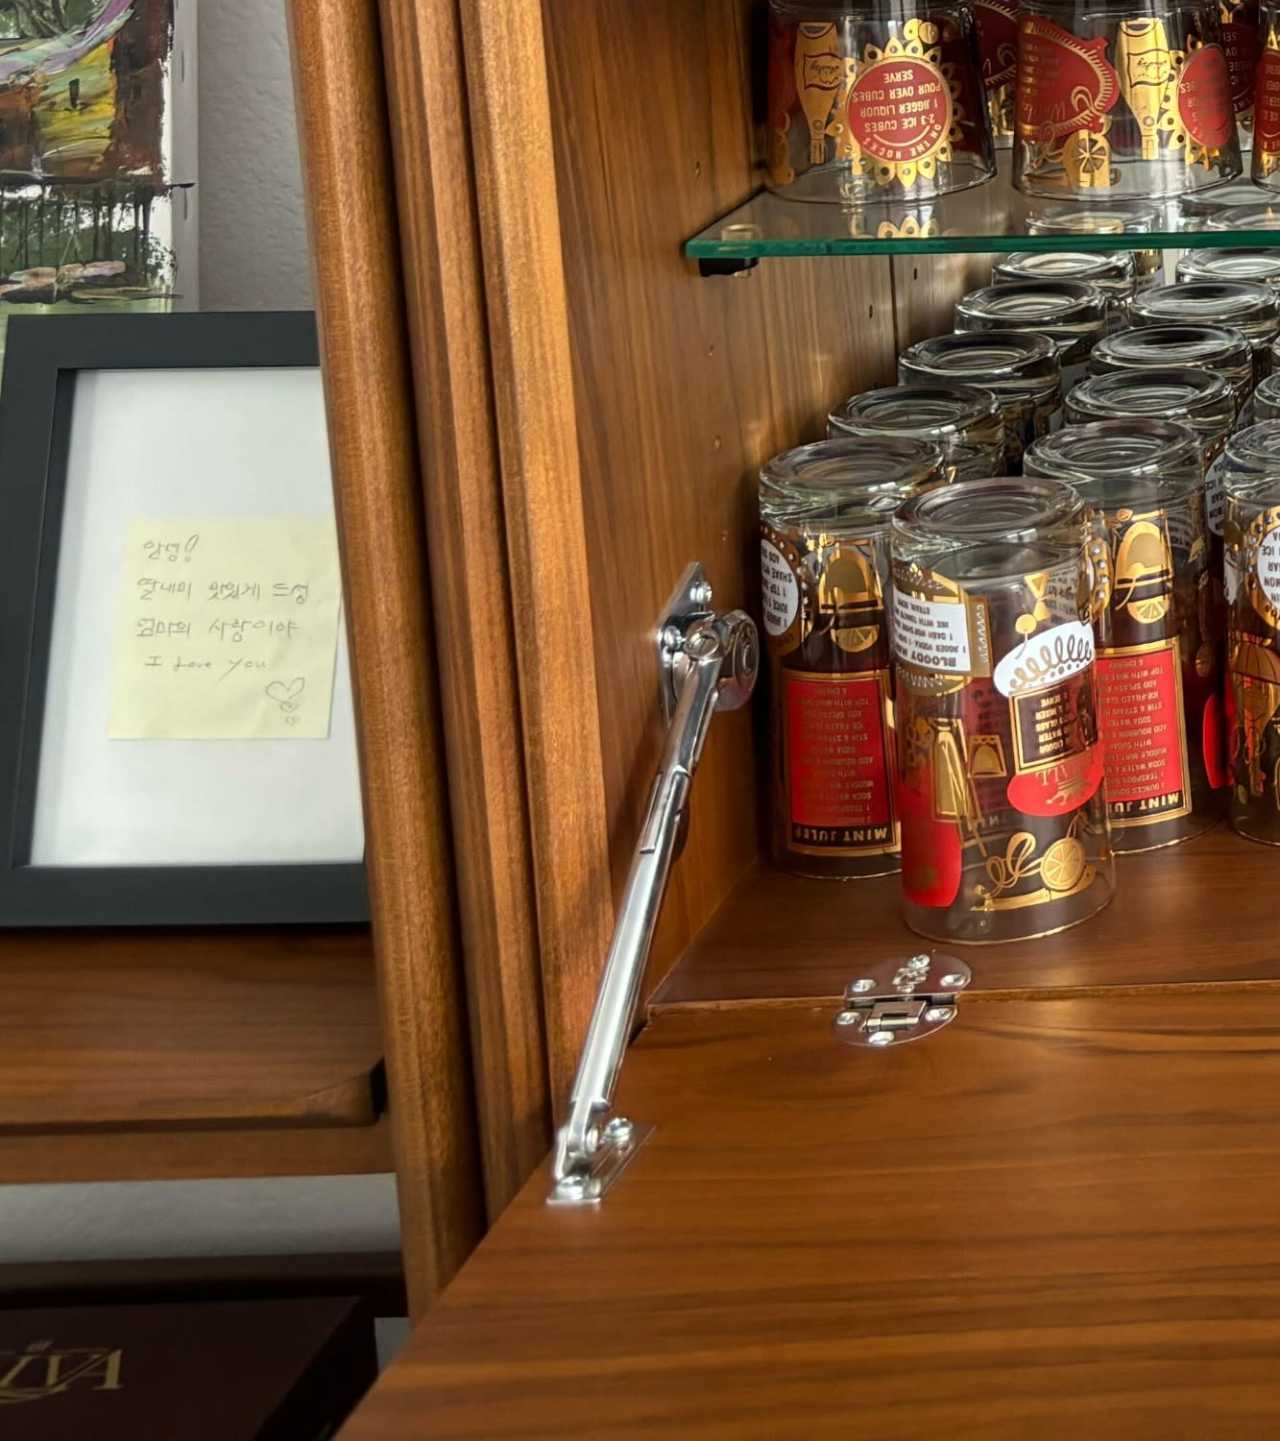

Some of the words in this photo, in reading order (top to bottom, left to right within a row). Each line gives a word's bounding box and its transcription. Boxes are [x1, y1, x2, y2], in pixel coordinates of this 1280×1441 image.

[883, 69, 913, 83] SERVE
[852, 90, 884, 103] CUBES
[889, 86, 914, 99] OVER
[860, 105, 895, 118] LIQUOR
[899, 99, 930, 114] JIGGER
[864, 120, 897, 133] CUBES
[901, 117, 917, 129] ICE
[1261, 545, 1274, 555] ICE
[208, 618, 301, 643] 사랑이야
[145, 655, 163, 666] I
[911, 651, 956, 667] BLOODY
[1139, 791, 1179, 810] MINT
[843, 827, 888, 841] MINT
